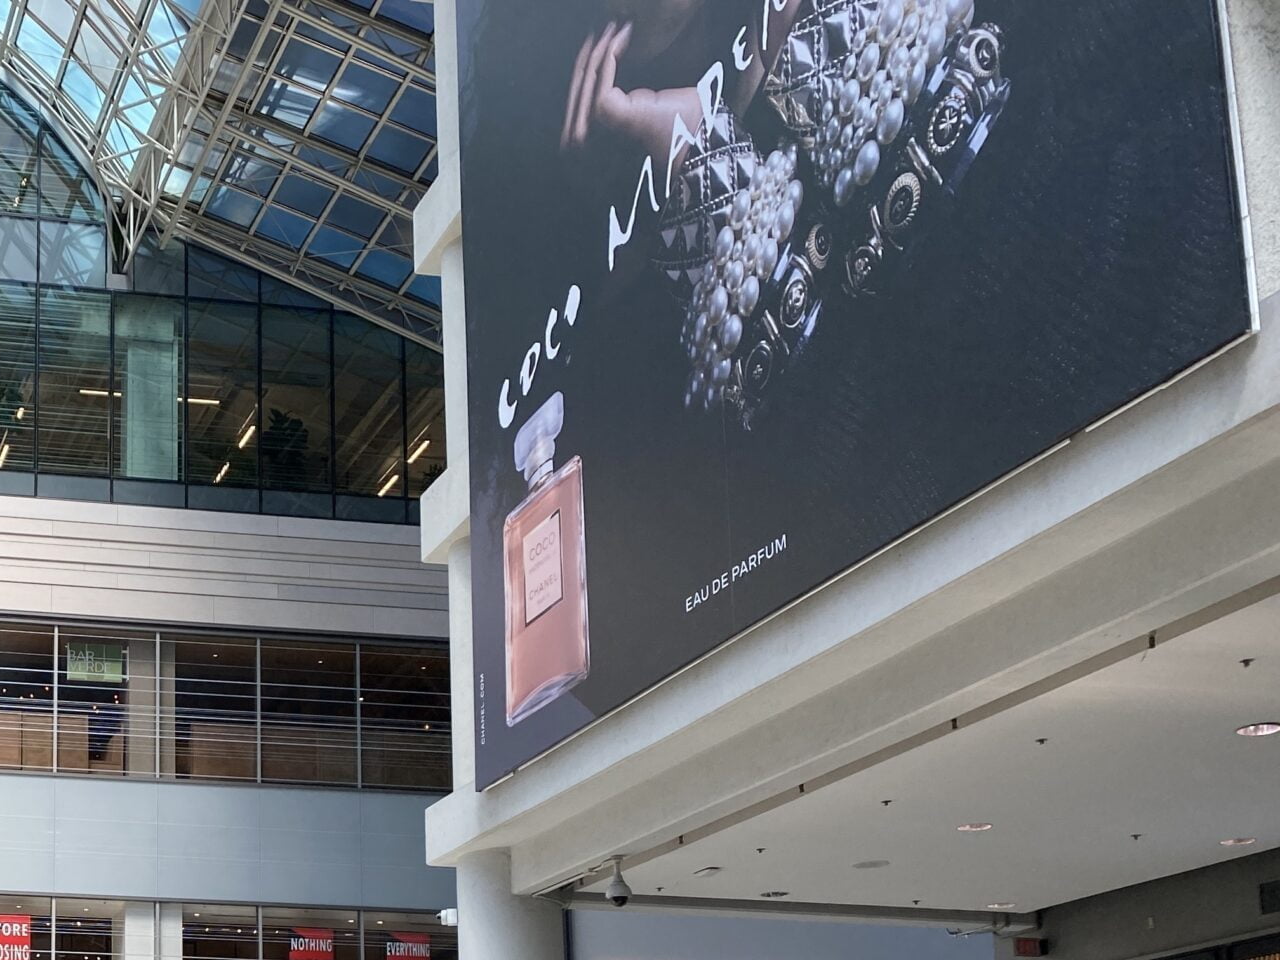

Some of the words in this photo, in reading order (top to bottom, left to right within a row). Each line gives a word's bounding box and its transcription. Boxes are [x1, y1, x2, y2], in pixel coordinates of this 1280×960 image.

[685, 585, 709, 612] EAU
[712, 572, 729, 595] DE
[731, 534, 787, 582] PARFUM
[68, 649, 95, 662] BAR
[69, 661, 112, 673] VERDE
[290, 937, 333, 952] NOTHING
[386, 942, 430, 957] EVERYTHING
